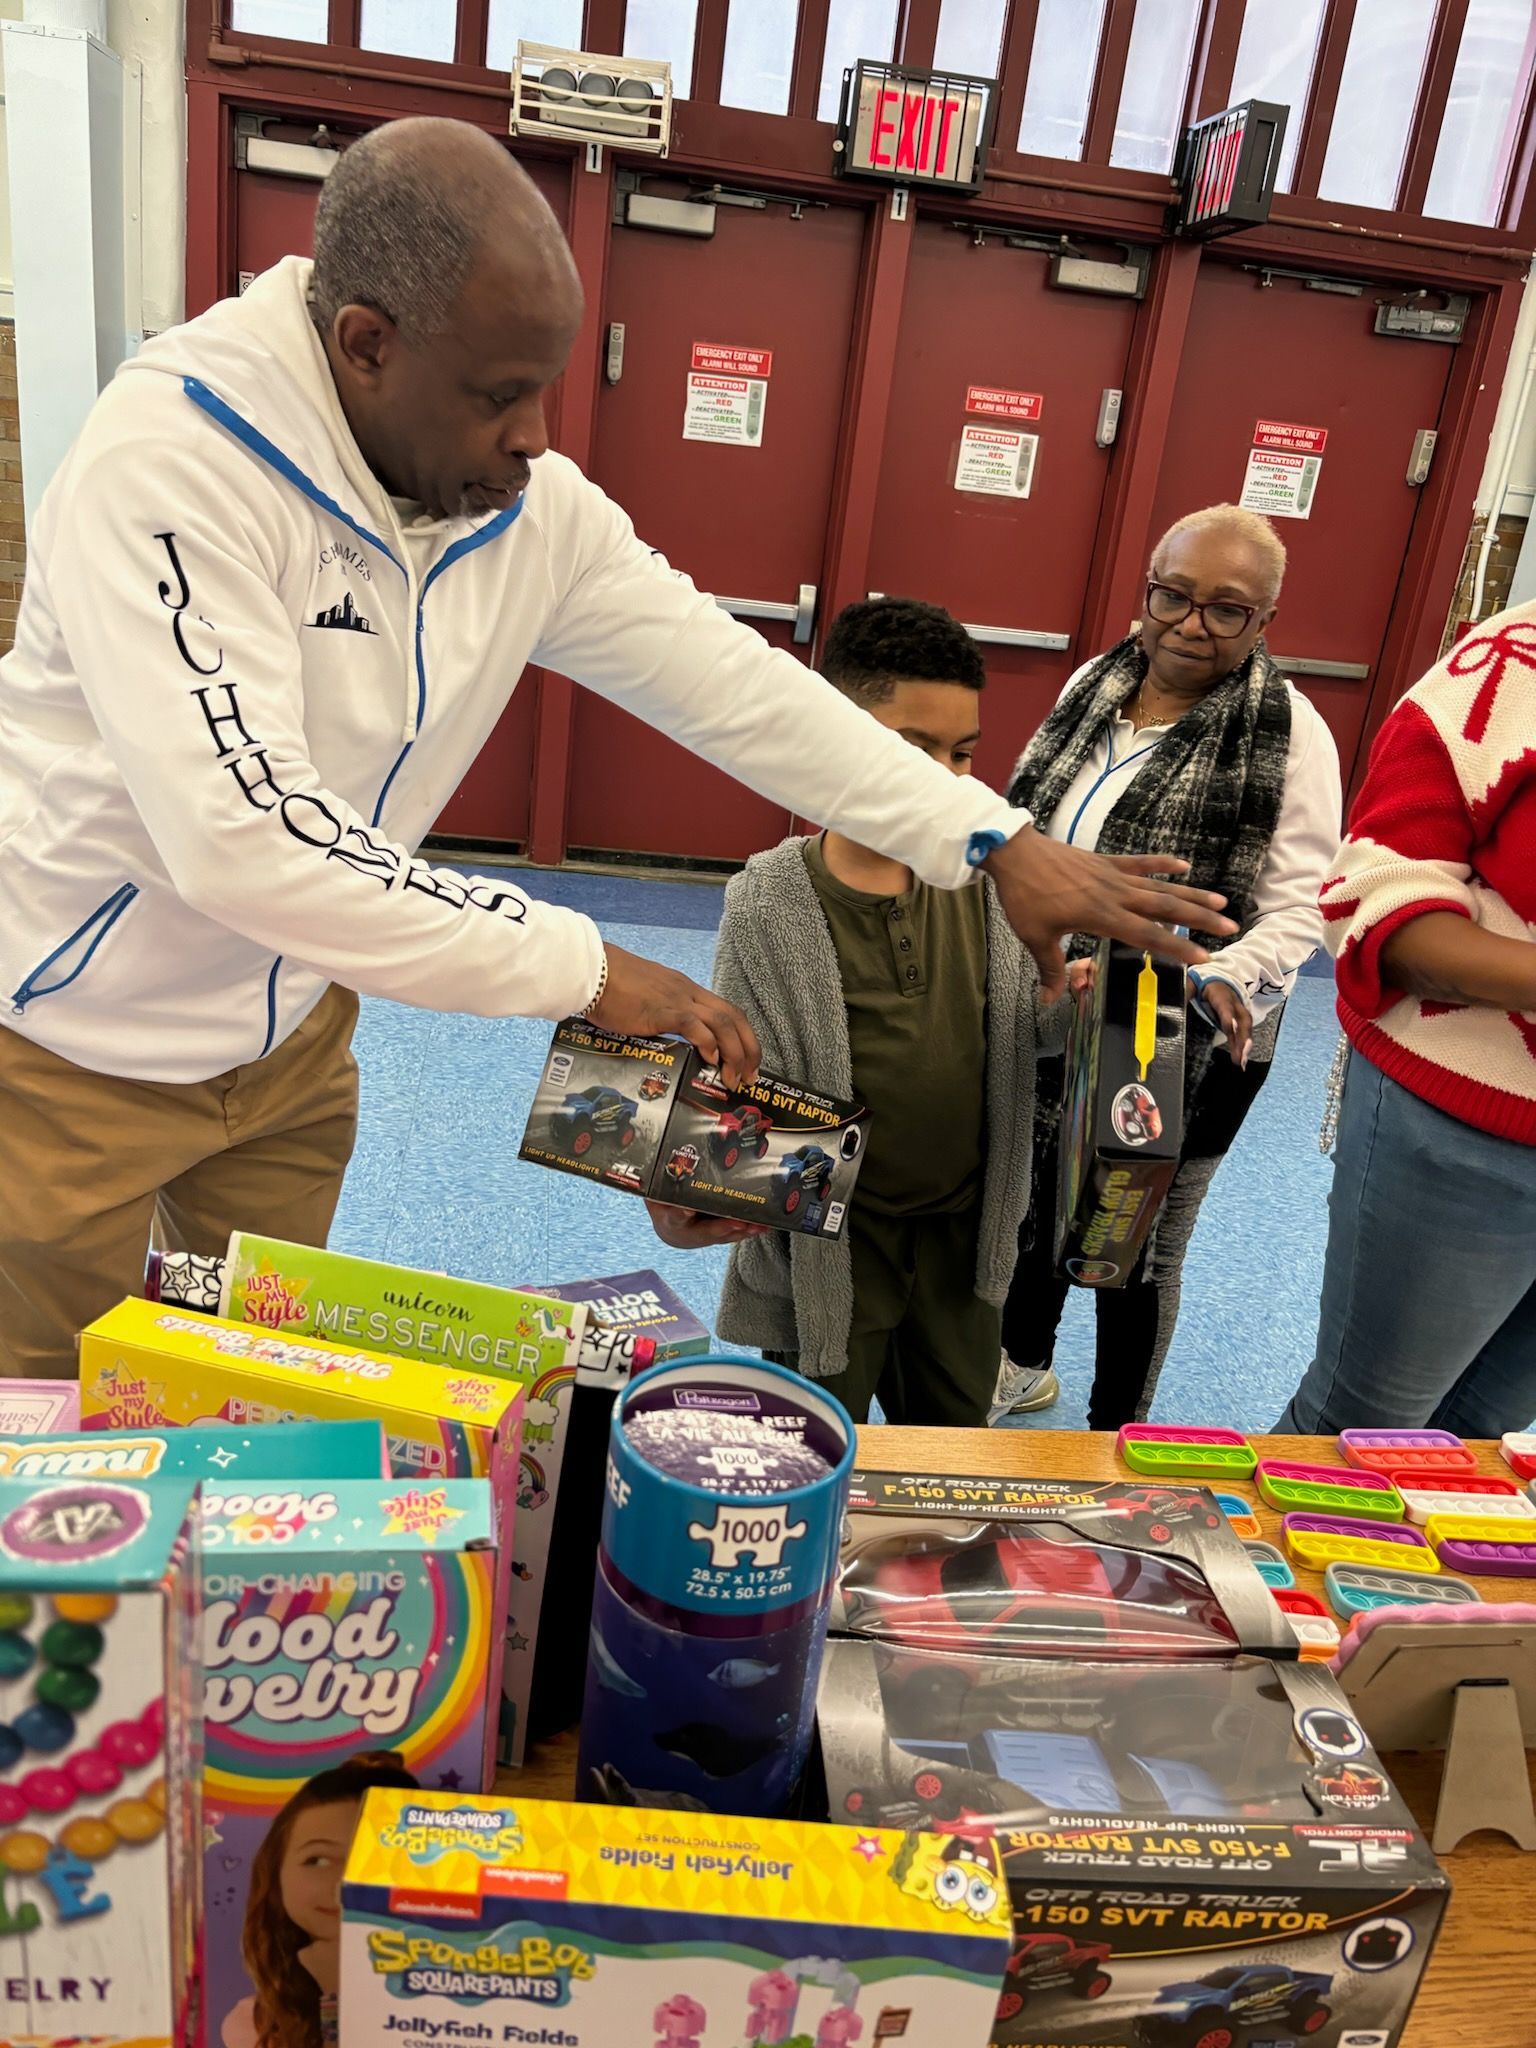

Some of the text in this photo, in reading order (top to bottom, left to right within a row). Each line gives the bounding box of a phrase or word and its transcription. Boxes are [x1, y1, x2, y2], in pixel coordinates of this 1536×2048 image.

[869, 90, 959, 173] EXIT
[592, 144, 598, 169] 1
[896, 191, 903, 217] 1
[696, 347, 764, 363] EMERGENCY EXIT ONLY
[701, 359, 758, 373] ALARM WILL SOUND
[693, 378, 746, 391] ATTENTION
[970, 390, 1035, 407] EMERGENCY EXIT ONLY
[975, 402, 1029, 416] ALARM WILL SOUND
[713, 415, 741, 424] GREEN
[968, 432, 1018, 444] ATTENTION
[1259, 424, 1320, 440] EMERGENCY EXIT ONLY
[1262, 435, 1313, 449] ALARM WILL SOUND
[988, 452, 1004, 460] RED
[1254, 454, 1302, 467] ATTENTION
[985, 468, 1012, 477] GREEN
[1269, 489, 1294, 498] GREEN
[572, 1023, 667, 1052] OFF ROAD TRUCK
[559, 1029, 675, 1067] F-150 SVT RAPTOR
[738, 1082, 770, 1103] F-150
[772, 1093, 797, 1112] SVT
[797, 1102, 841, 1127] RAPTOR
[773, 1081, 802, 1098] ROAD
[804, 1092, 835, 1110] TRUCK
[525, 1146, 545, 1157] LIGHT
[557, 1156, 600, 1175] HEADLIGHTS
[690, 1180, 767, 1205] LIGHT UP HEADLIGHTS
[1100, 1171, 1131, 1209] GLOW
[1080, 1210, 1116, 1257] TRACKS
[247, 1274, 280, 1292] JUST
[266, 1288, 288, 1303] MY
[582, 1290, 661, 1312] BOTTL
[243, 1298, 308, 1329] Style
[383, 1290, 475, 1323] unicorn
[155, 1314, 253, 1348] Beads
[314, 1299, 542, 1377] MESSENGER
[251, 1337, 393, 1379] Alphabet
[106, 1378, 146, 1397] Just
[446, 1378, 497, 1396] Style
[124, 1396, 145, 1409] my
[107, 1404, 165, 1429] Style
[635, 1410, 675, 1424] LIFE
[715, 1414, 756, 1429] THE
[762, 1416, 808, 1429] REEF
[648, 1428, 676, 1441] LA
[684, 1428, 714, 1442] VIE
[721, 1429, 748, 1443] AU
[716, 1453, 759, 1466] 1000
[883, 1484, 1097, 1505] F-150 SVT RAPTOR
[901, 1477, 1071, 1493] OFF ROAD TRUCK
[384, 1489, 447, 1517] Style
[914, 1501, 1067, 1515] LIGHT UP HEADLIGHTS
[721, 1519, 780, 1543] 1000
[691, 1565, 792, 1585] 28.5" x 19.75"
[686, 1581, 792, 1600] 72.5 x 50.5 cm
[1321, 1794, 1391, 1803] FUNCTION
[407, 1809, 502, 1828] SQUAREPANTS
[1049, 1816, 1247, 1834] LIGHT UP HEADLIGHTS
[636, 1832, 761, 1851] CONSTRUCTION SET
[1301, 1828, 1407, 1837] RADIO CONTROL
[1009, 1831, 1292, 1858] F-150 SVT RAPTOR
[599, 1846, 794, 1881] Jellyfish Fields
[1043, 1851, 1273, 1871] OFF ROAD TRUCK
[1025, 1888, 1303, 1909] OFF ROAD TRUCK
[1013, 1905, 1330, 1930] -150 SVT RAPTOR
[407, 1968, 559, 2000] SQUAREPANTS
[382, 2014, 578, 2047] Jellyfish Fields
